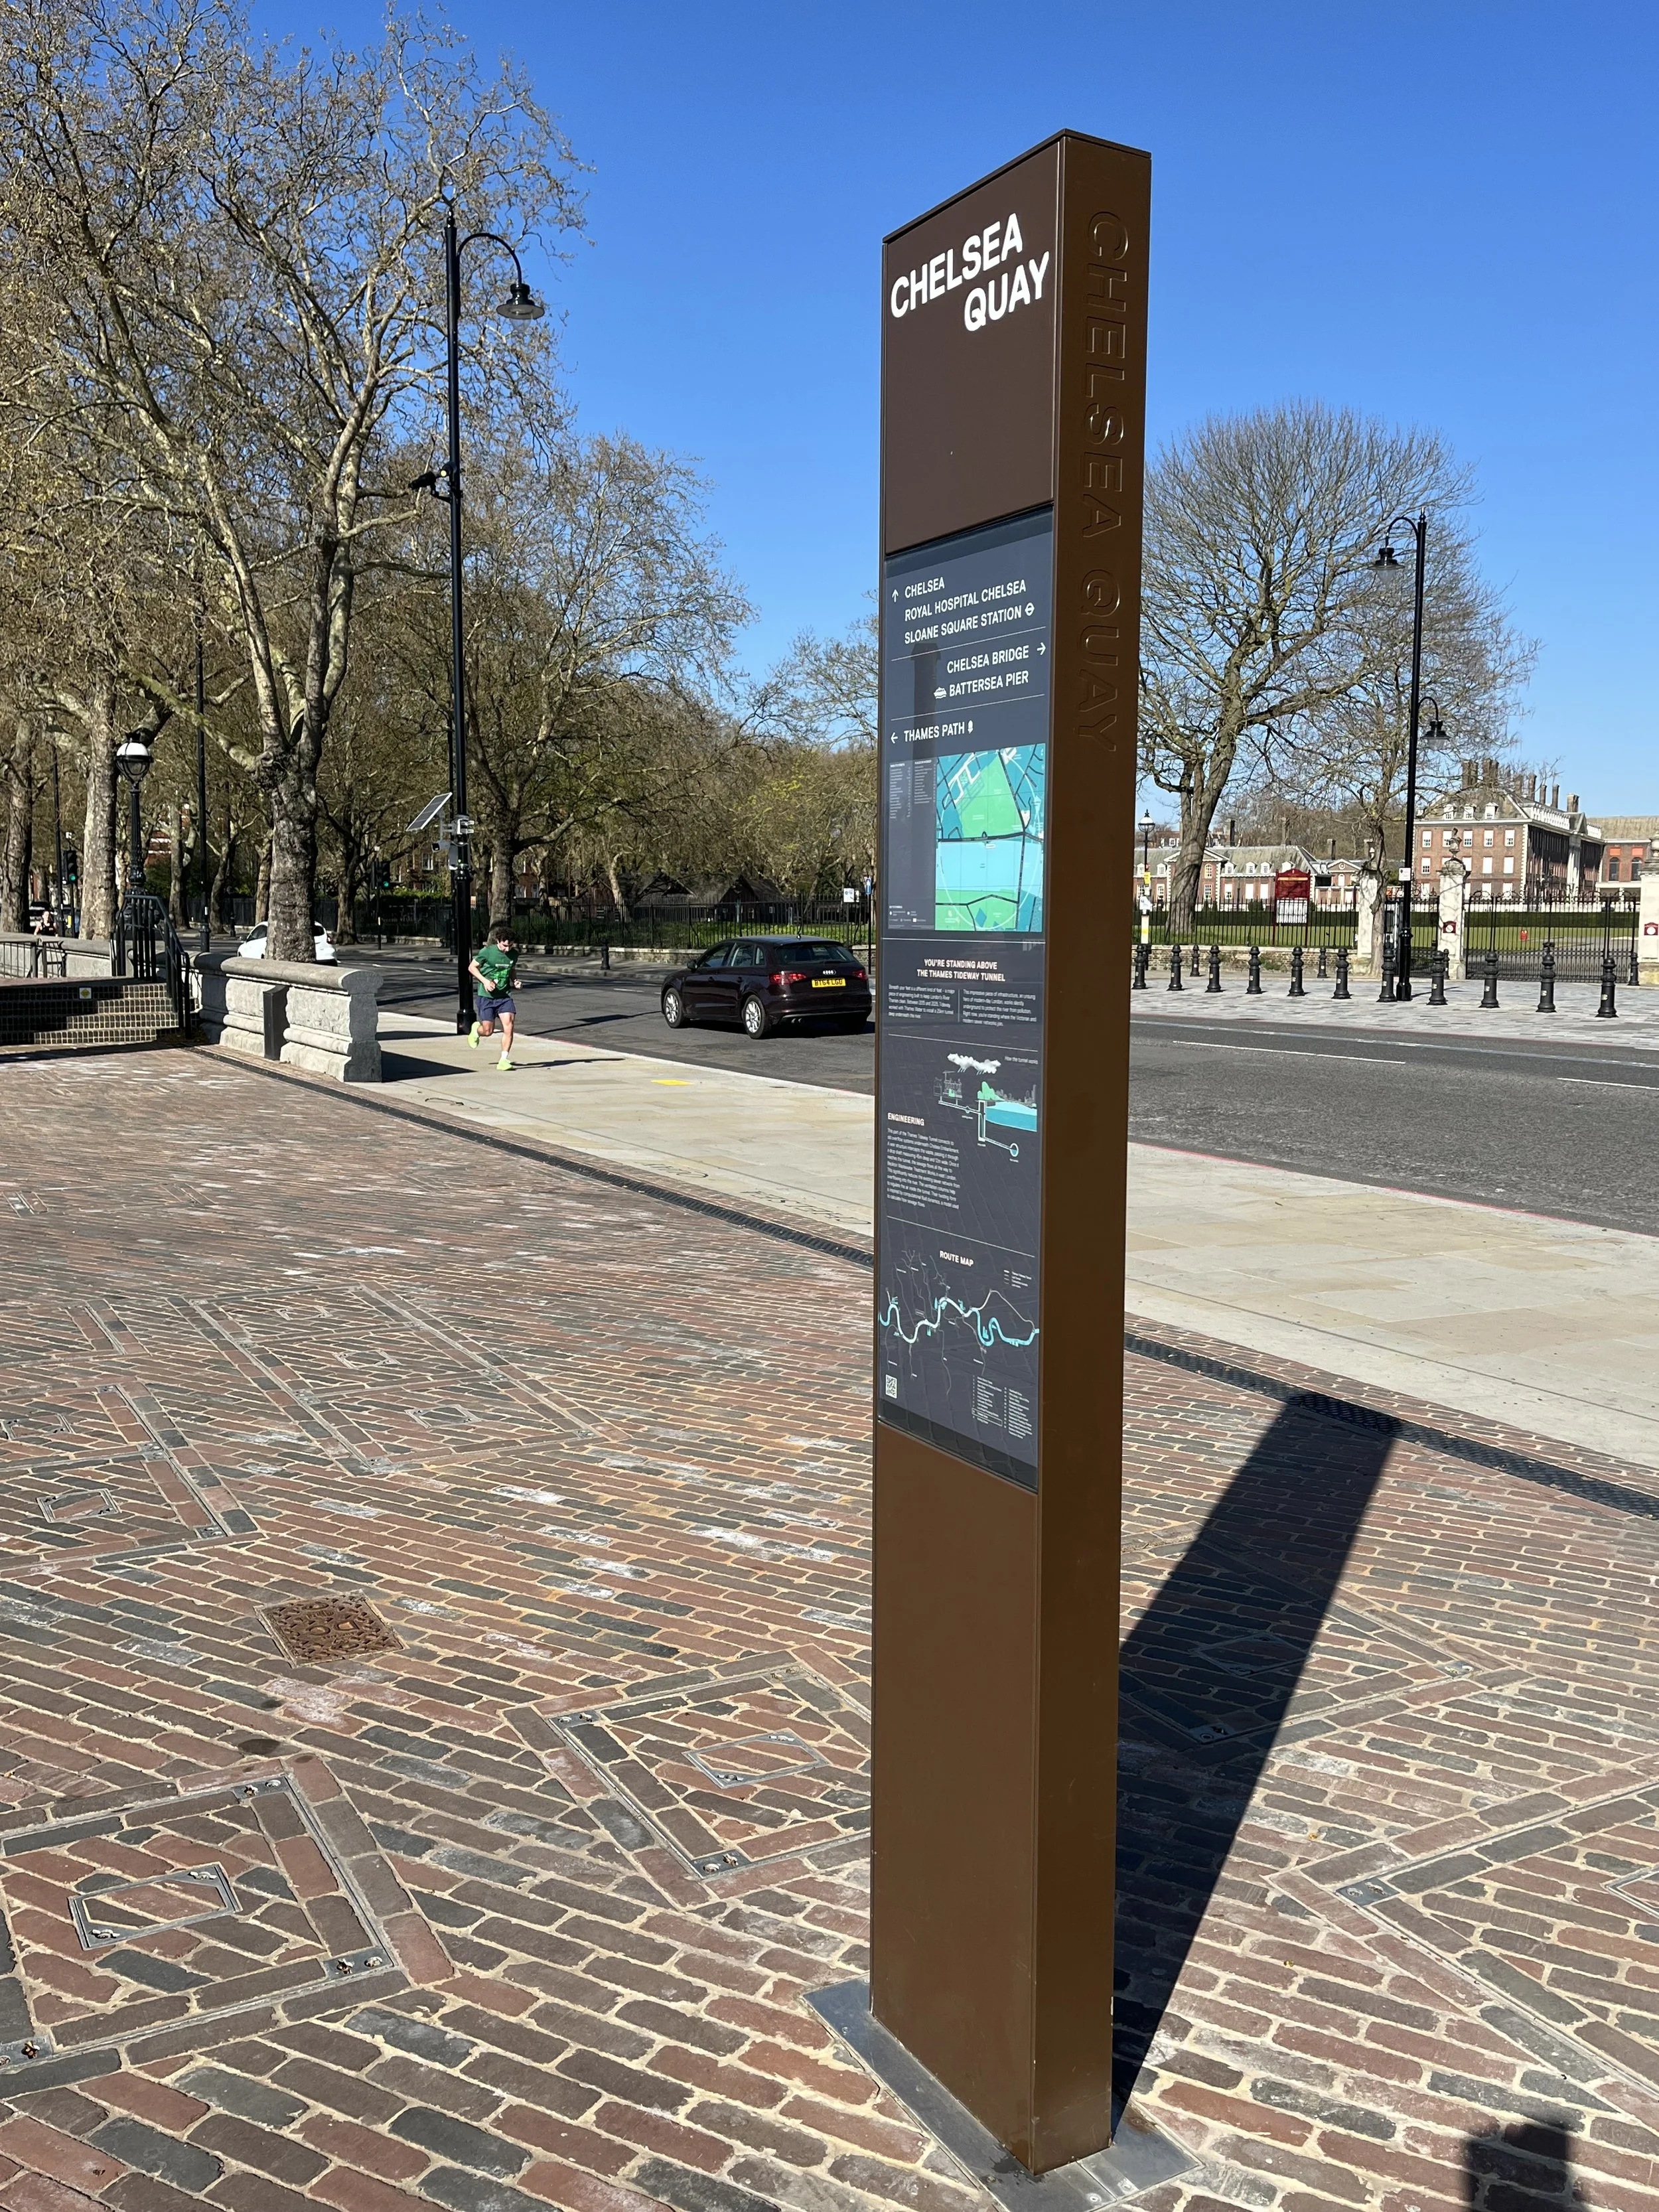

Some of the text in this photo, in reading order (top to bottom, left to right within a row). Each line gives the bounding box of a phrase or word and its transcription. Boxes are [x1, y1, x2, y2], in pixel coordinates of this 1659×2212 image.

[891, 213, 1023, 317] CHELSEA
[965, 252, 1049, 331] QUAY
[1078, 211, 1129, 751] CHELSEA QUAY
[905, 577, 944, 598] CHELSEA
[905, 579, 1026, 621] ROYAL HOSPITAL CHELSEA
[904, 605, 1021, 644] SLOANE SQUARE STATION
[947, 645, 1029, 673] CHELSEA BRIDGE
[950, 670, 1029, 696] BATTERSEA PIER
[904, 722, 964, 741] THAMES PATH
[917, 969, 1006, 982] THE THAMES TIDEWAY TUNNEL
[946, 960, 975, 968] STANDING
[887, 1112, 925, 1126] ENGINEERING
[940, 1250, 974, 1267] ROUTE MAP
